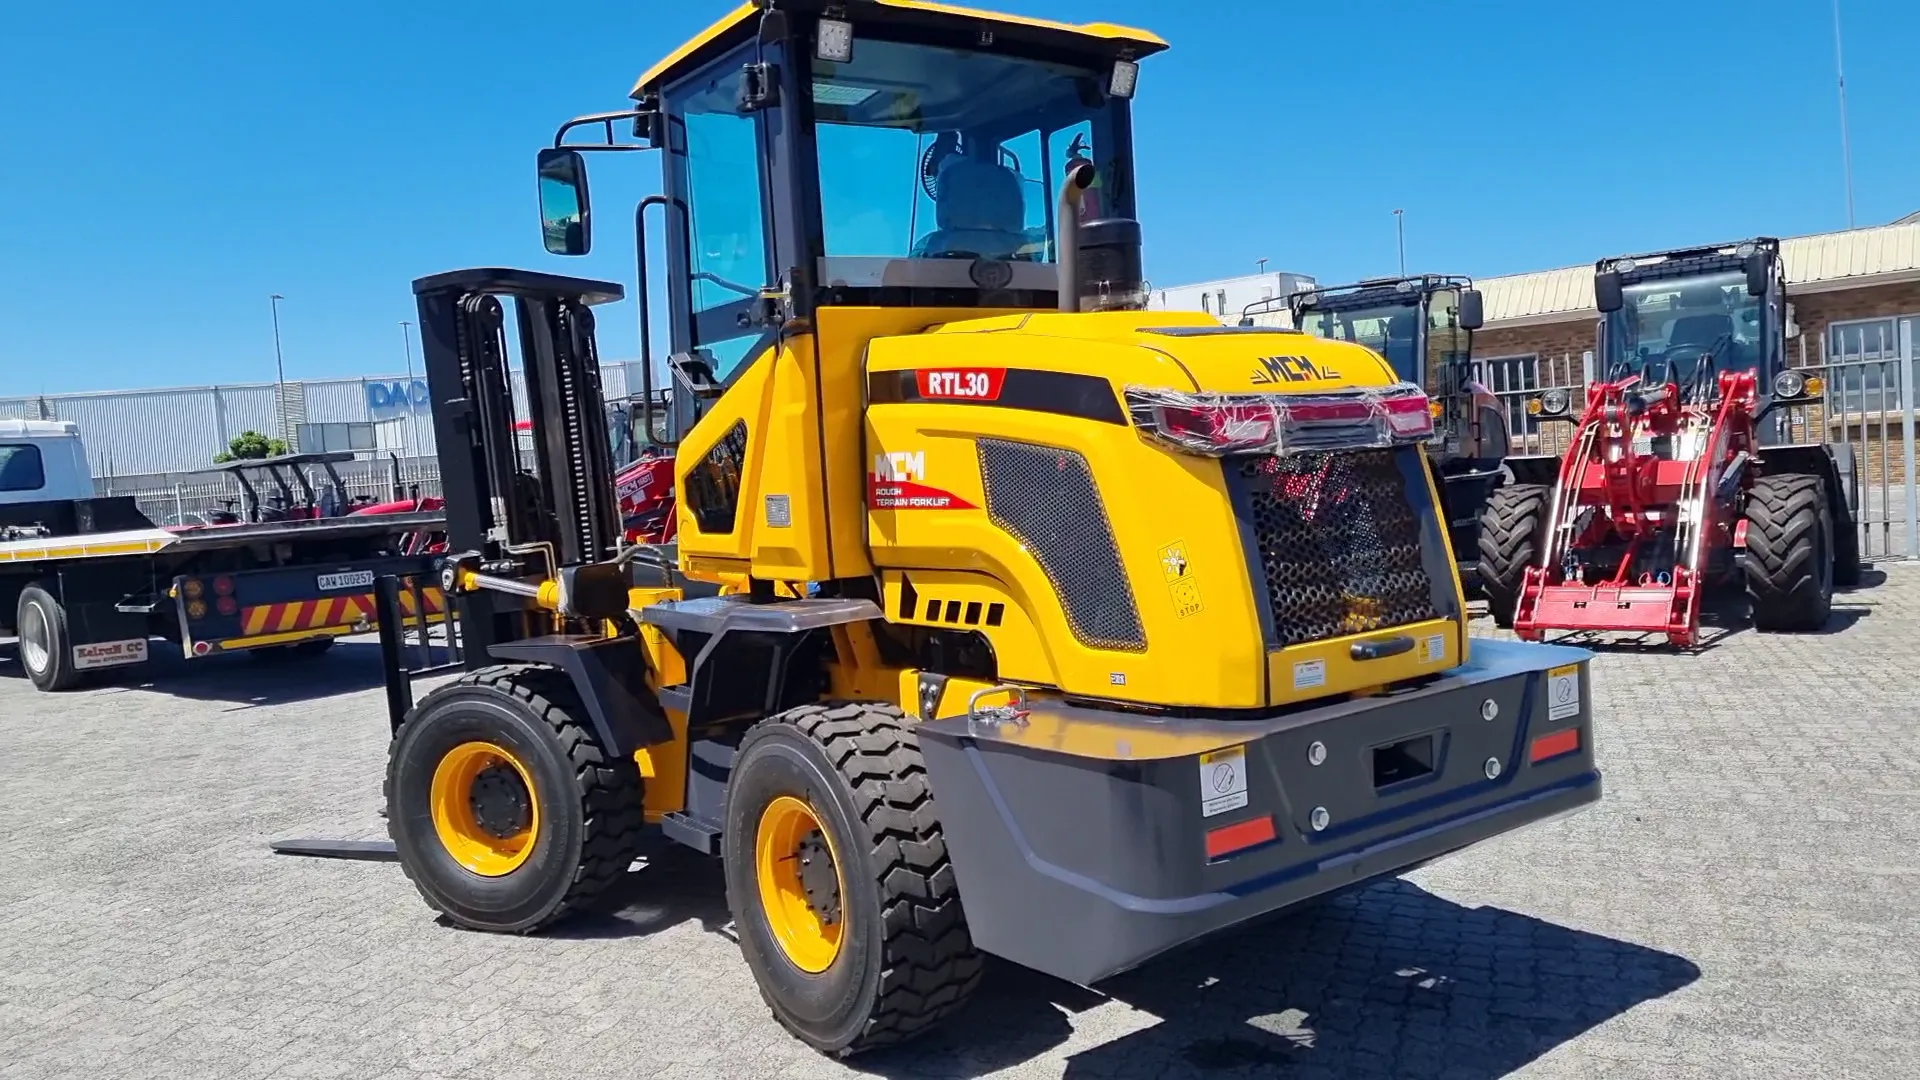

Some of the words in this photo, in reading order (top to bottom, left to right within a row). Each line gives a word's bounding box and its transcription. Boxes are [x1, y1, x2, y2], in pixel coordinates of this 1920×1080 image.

[1257, 355, 1322, 383] MCM
[928, 371, 989, 397] RTL30
[874, 451, 925, 482] MCM
[875, 487, 902, 496] ROUGH
[875, 498, 907, 507] TERRAIN
[909, 497, 951, 507] FORKLIFT
[319, 575, 337, 589] CAW
[338, 571, 372, 587] 100257
[1180, 603, 1199, 616] STOP
[127, 642, 143, 652] CC
